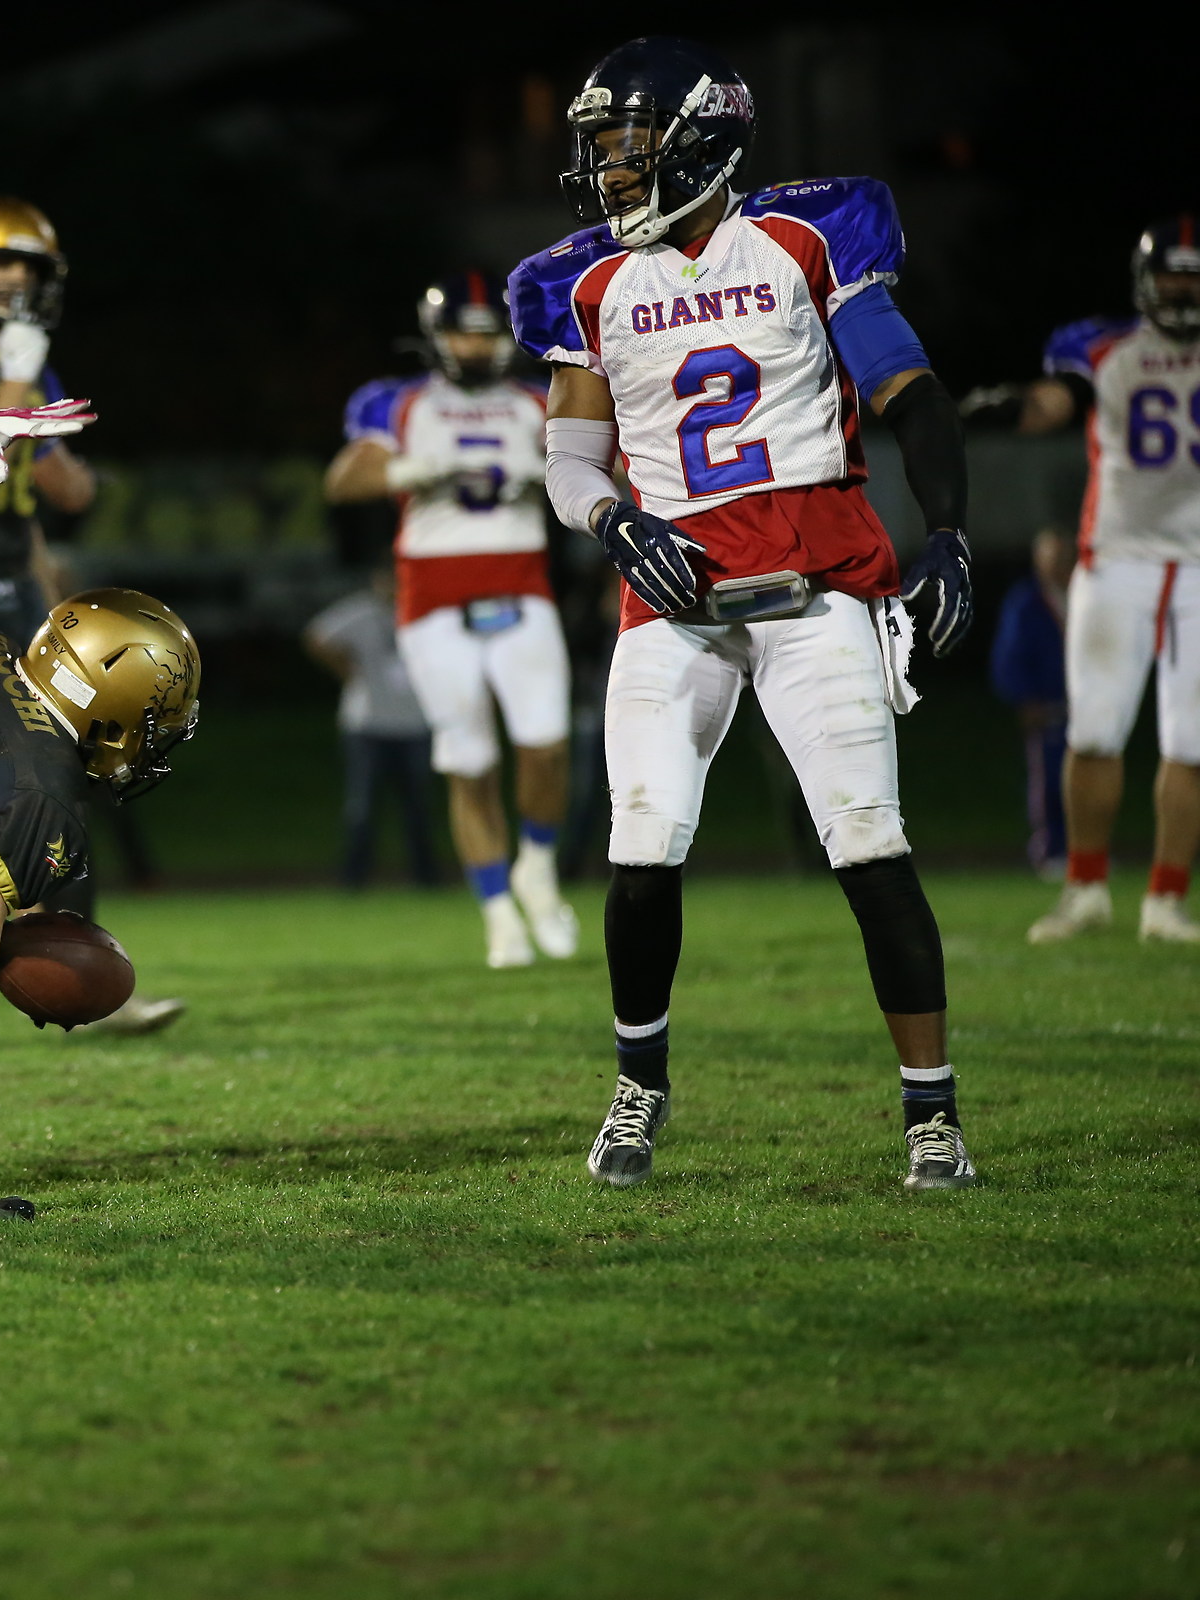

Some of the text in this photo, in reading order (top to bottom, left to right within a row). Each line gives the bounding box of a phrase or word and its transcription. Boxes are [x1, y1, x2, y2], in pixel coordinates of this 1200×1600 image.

[785, 183, 833, 196] aew
[631, 282, 777, 335] GIANTS
[671, 343, 775, 500] 2
[1128, 386, 1200, 468] 6
